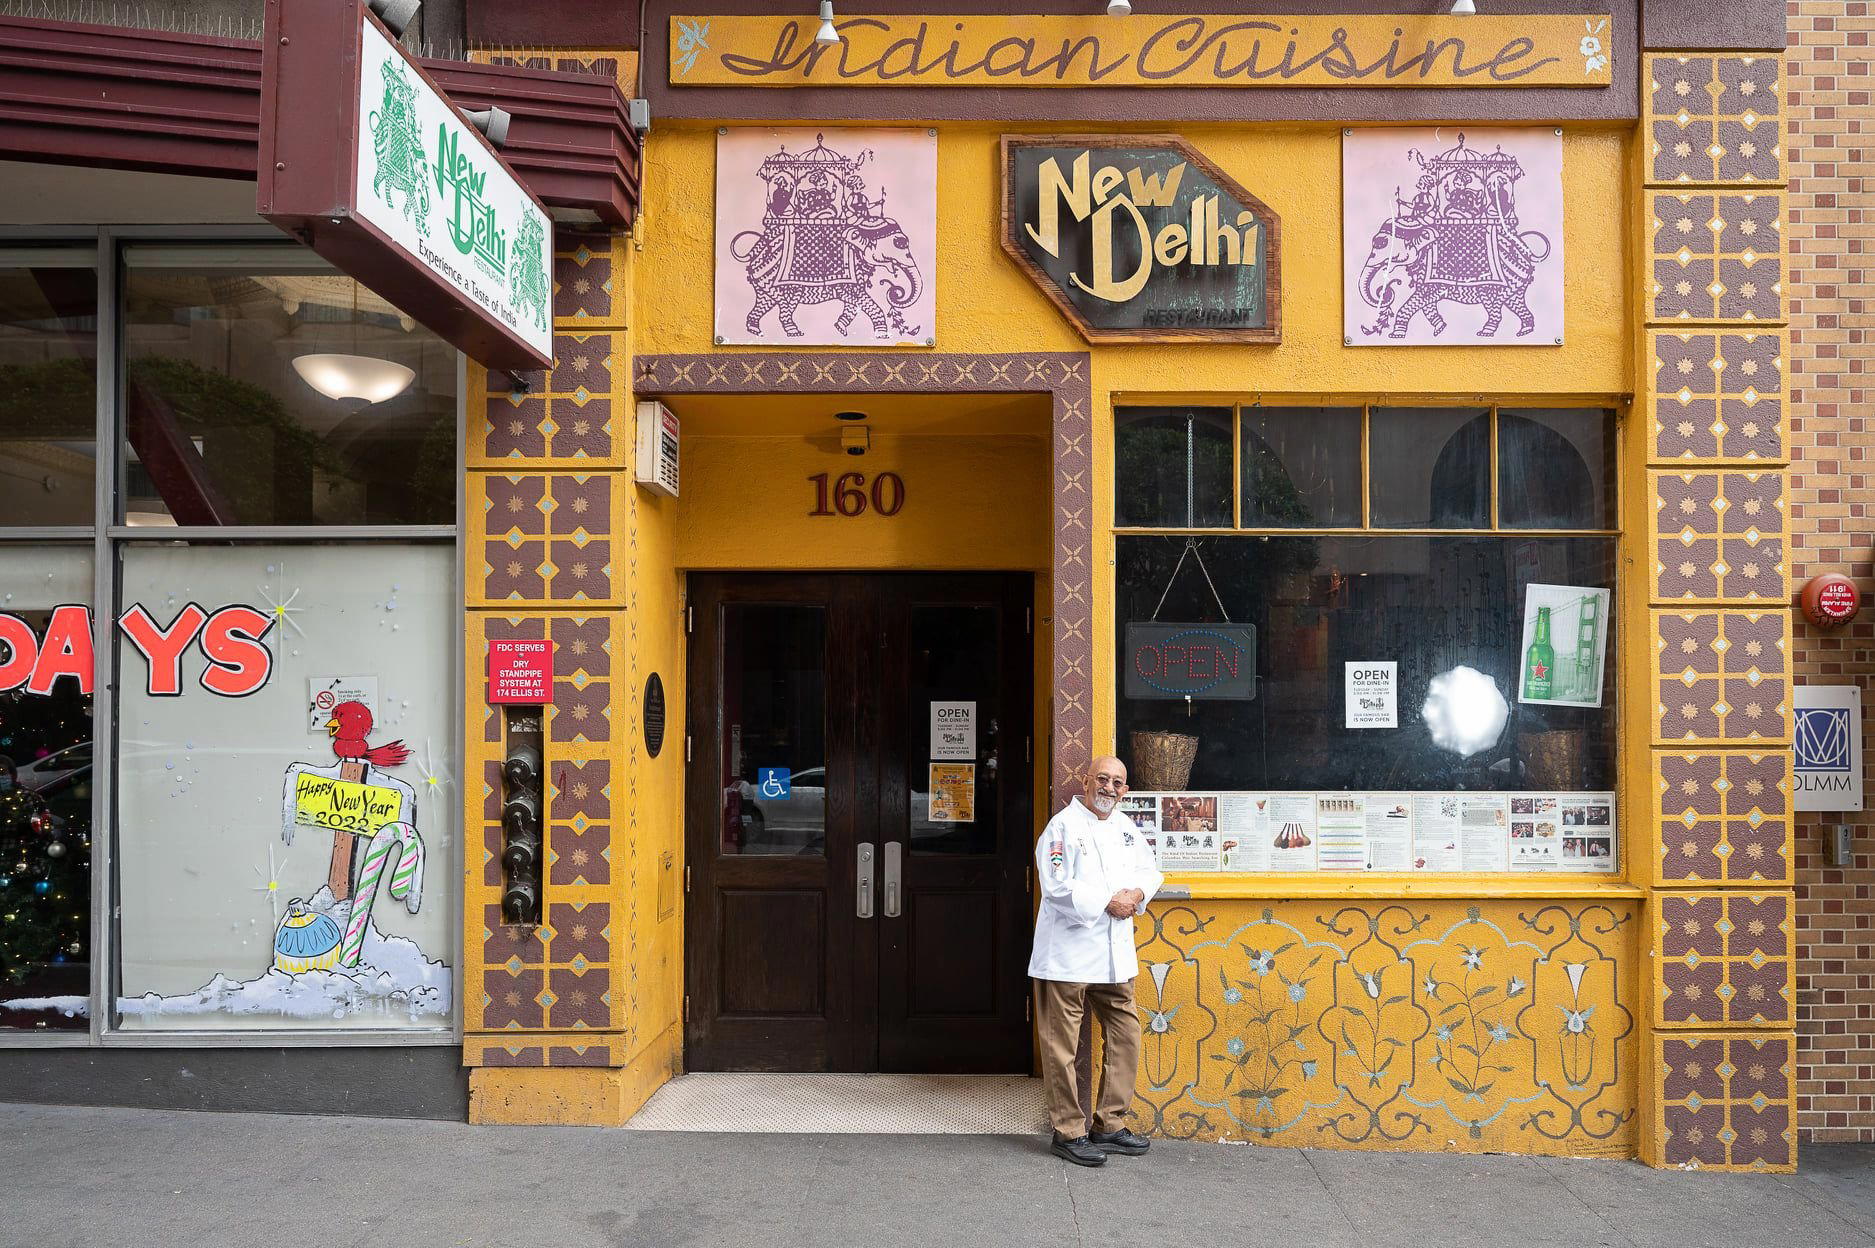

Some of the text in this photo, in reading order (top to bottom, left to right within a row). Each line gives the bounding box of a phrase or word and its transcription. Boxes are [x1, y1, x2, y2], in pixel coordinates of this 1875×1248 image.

[720, 17, 1560, 81] Indian Cuisine
[432, 122, 486, 200] New
[446, 176, 505, 255] Delhi
[1024, 150, 1187, 259] New
[1069, 192, 1259, 303] Delhi
[419, 238, 517, 328] Experience a Taste of India
[474, 255, 505, 289] RESTAURANT
[1142, 307, 1253, 327] RESTAURANT
[806, 472, 905, 517] 160
[497, 644, 545, 652] FDC SERVES
[1136, 645, 1239, 678] OPEN
[500, 670, 542, 678] STANDPIPE
[513, 660, 529, 668] DRY
[1353, 670, 1389, 680] OPEN
[496, 689, 545, 697] 174 ELLIS ST.
[500, 679, 542, 687] SYSTEM AT
[937, 708, 969, 718] OPEN
[297, 779, 336, 801] Happy
[329, 787, 394, 819] New Year
[315, 811, 370, 833] 2022
